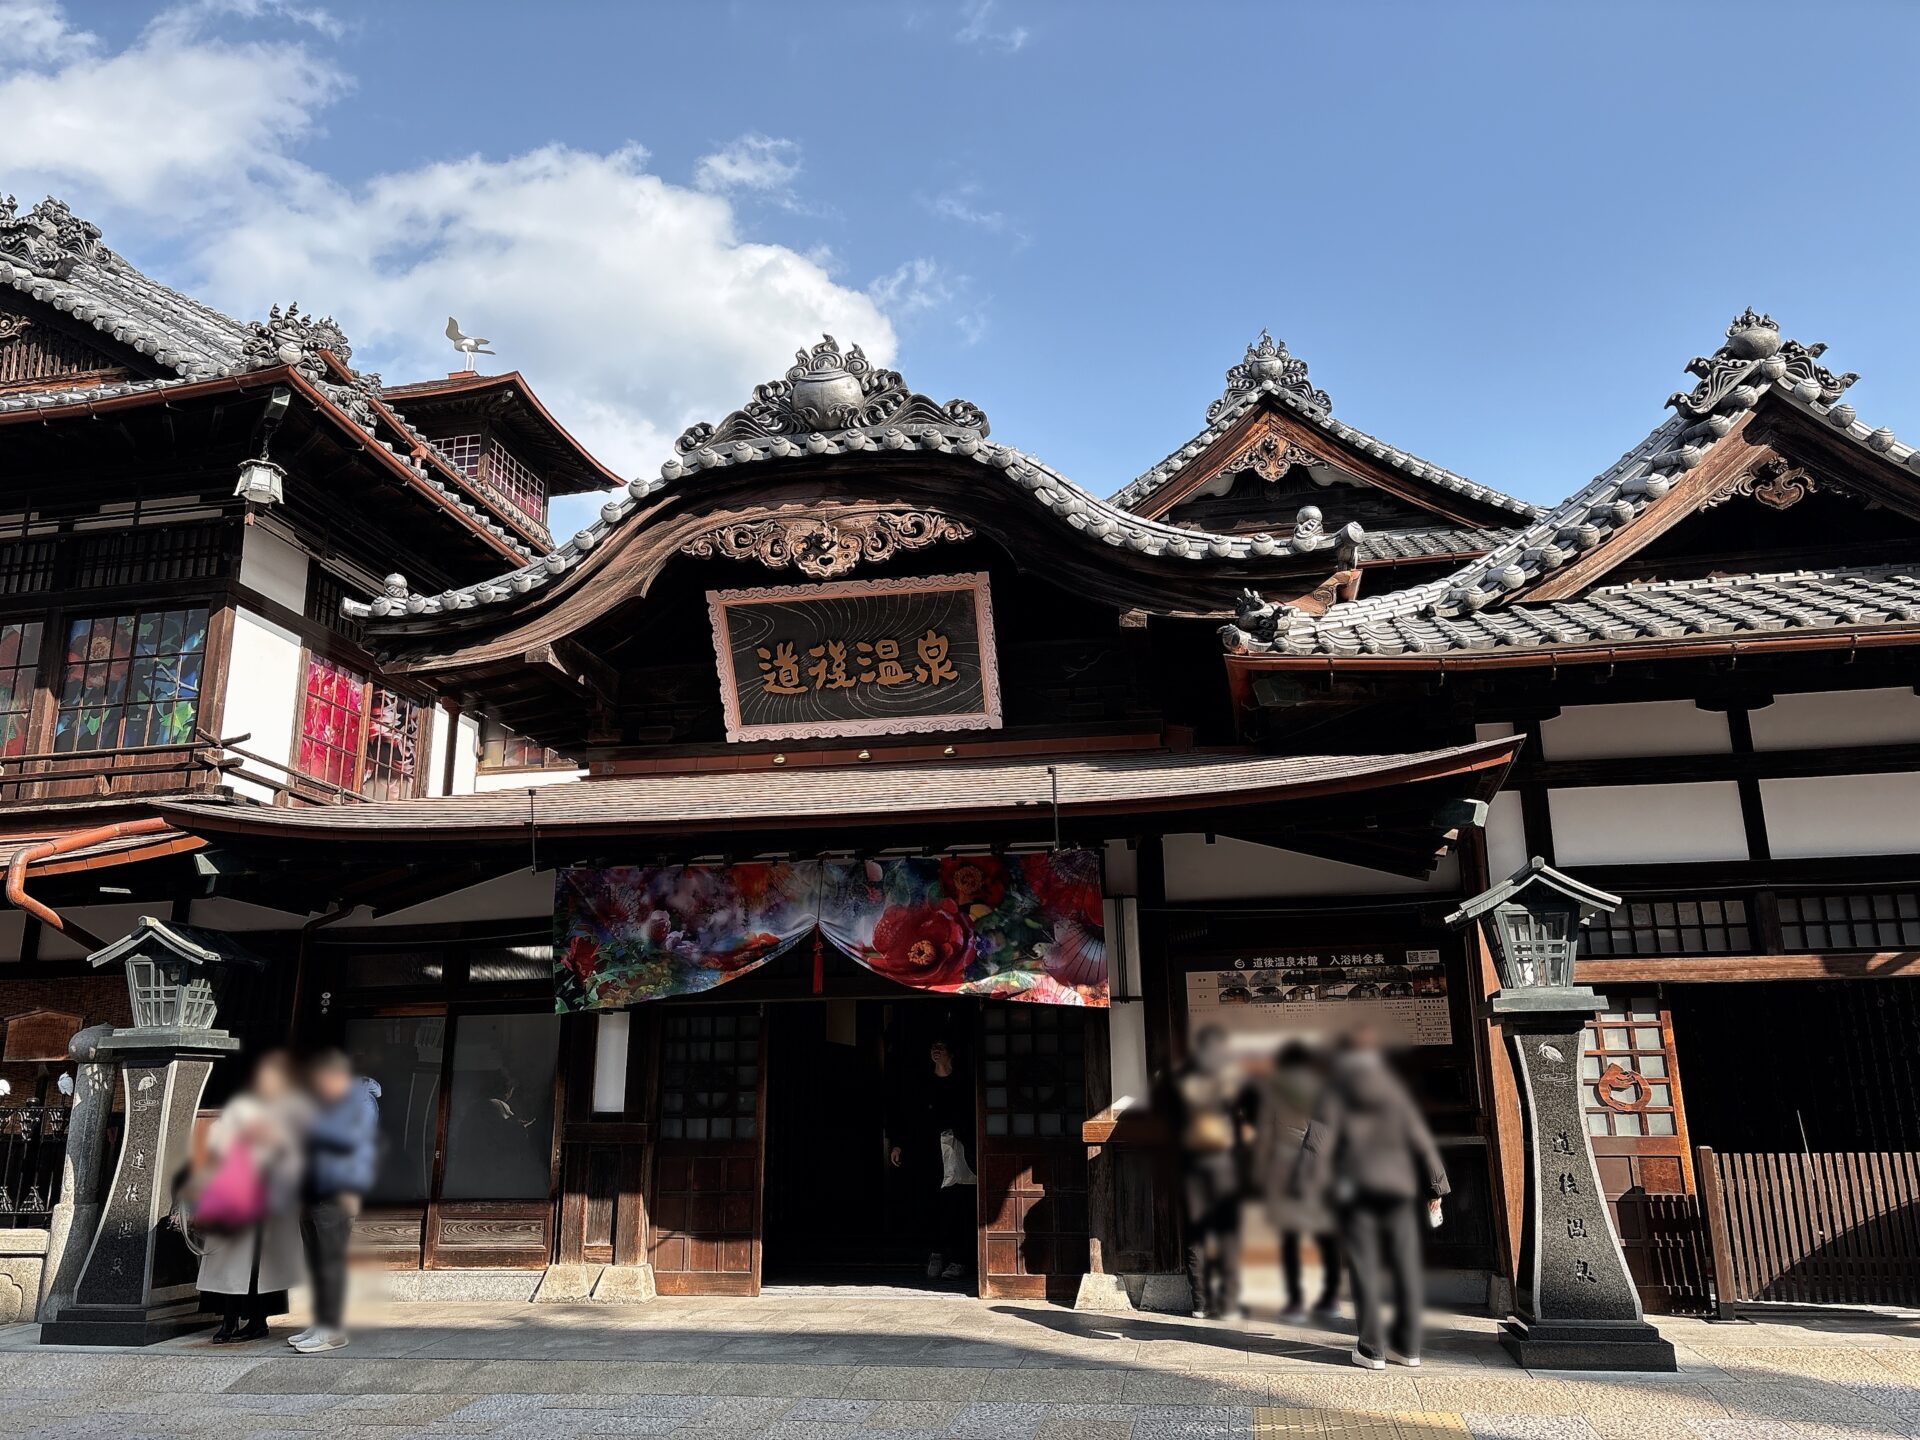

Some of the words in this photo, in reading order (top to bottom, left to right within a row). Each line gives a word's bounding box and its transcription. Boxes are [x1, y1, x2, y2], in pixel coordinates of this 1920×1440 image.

[757, 630, 958, 694] 道後温泉
[1252, 956, 1318, 968] 道後温泉本館
[1330, 953, 1386, 966] 入浴料金表
[1552, 1131, 1597, 1283] 道後温泉
